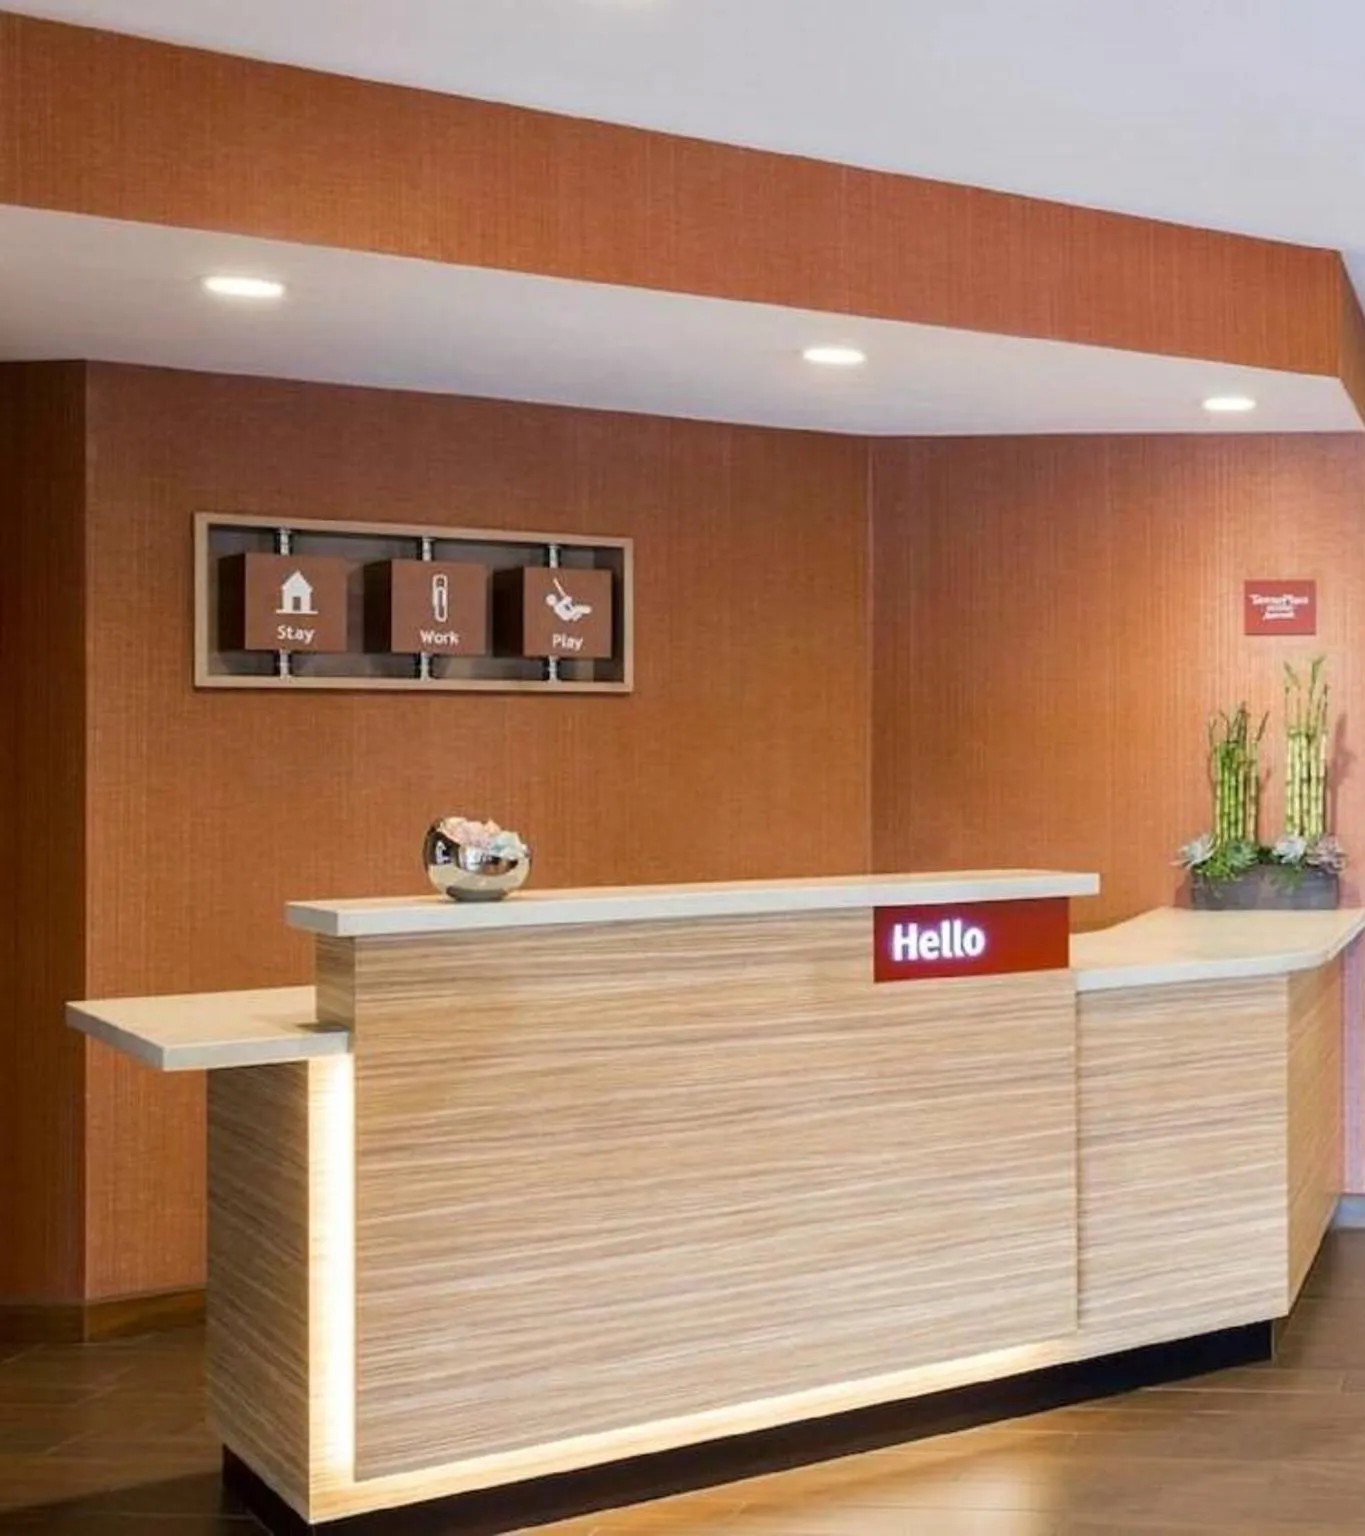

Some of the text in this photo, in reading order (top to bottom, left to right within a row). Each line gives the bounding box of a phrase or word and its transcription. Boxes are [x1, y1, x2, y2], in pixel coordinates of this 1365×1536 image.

[276, 624, 316, 644] Stay
[420, 628, 459, 647] Work
[552, 631, 584, 651] Play
[892, 918, 985, 961] Hello
